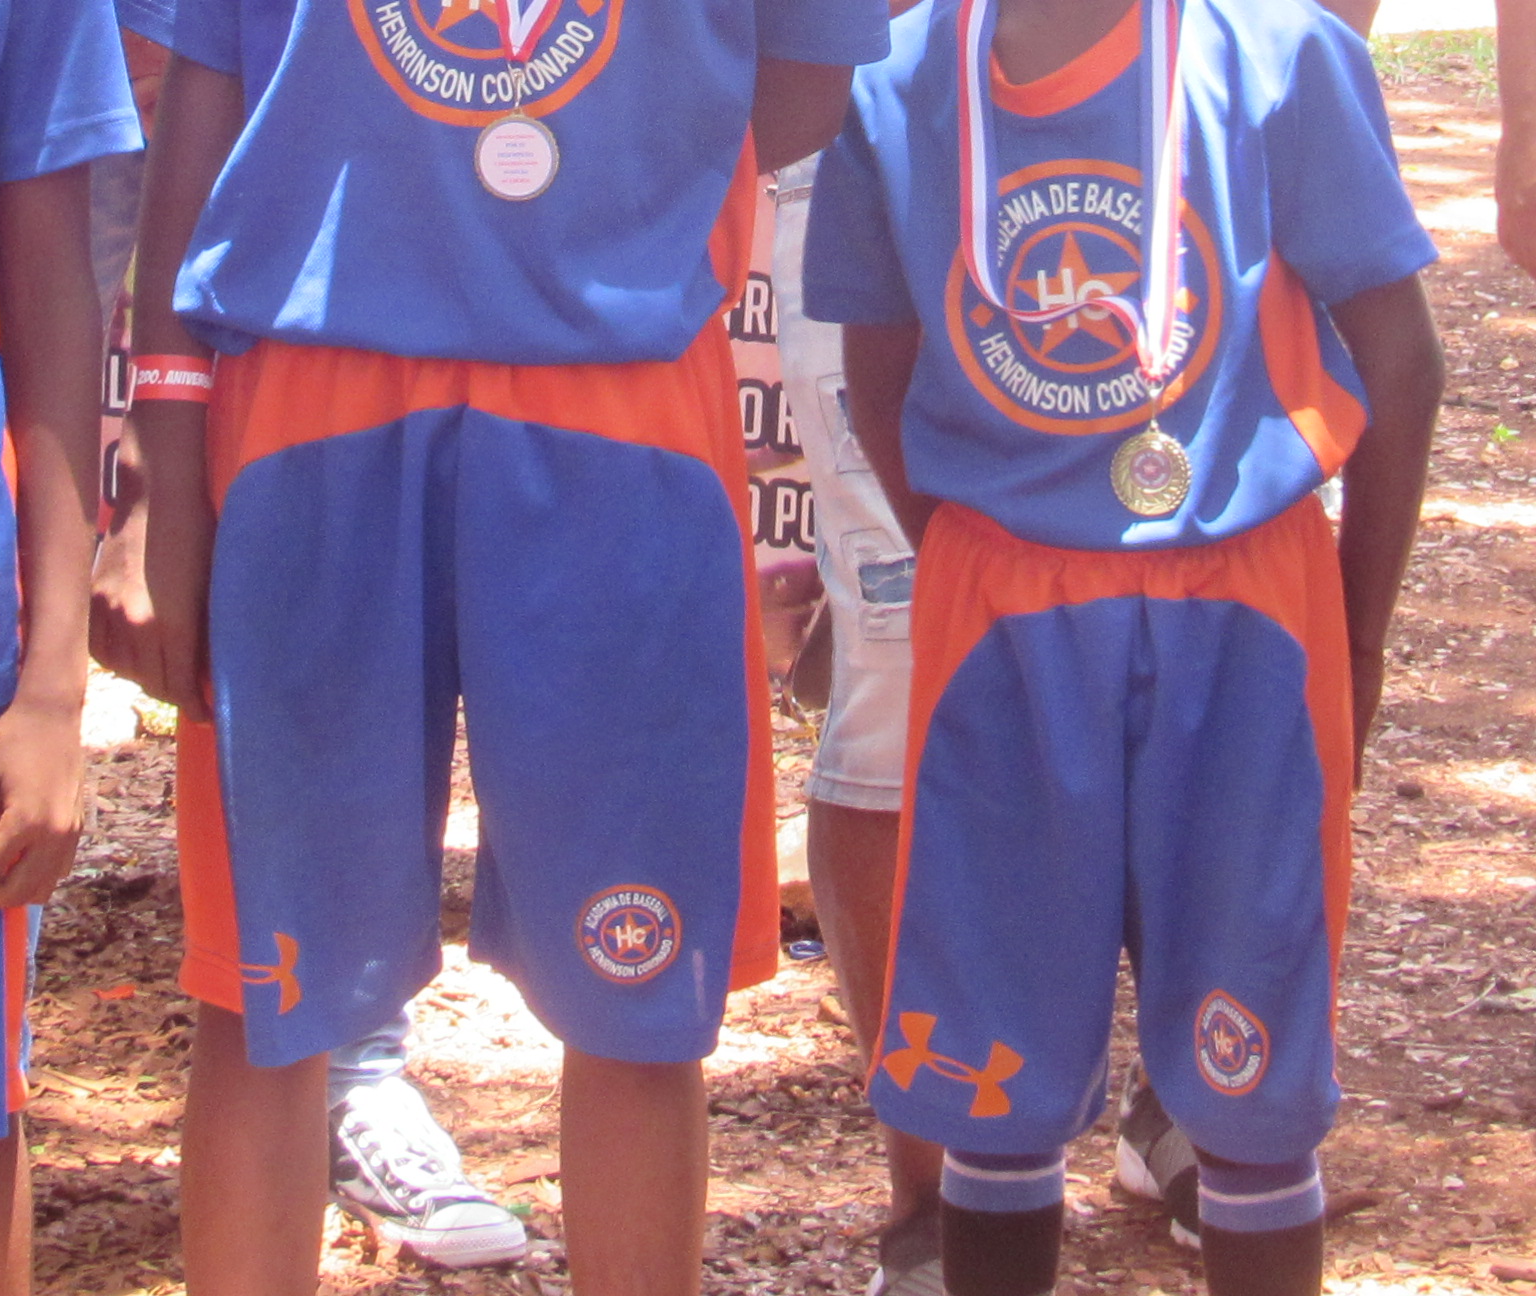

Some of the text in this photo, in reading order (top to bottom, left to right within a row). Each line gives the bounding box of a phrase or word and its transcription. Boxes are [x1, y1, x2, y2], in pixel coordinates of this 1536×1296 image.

[375, 0, 475, 104] HENRINSON
[1049, 182, 1081, 216] DE
[979, 332, 1090, 414] HENRINSON
